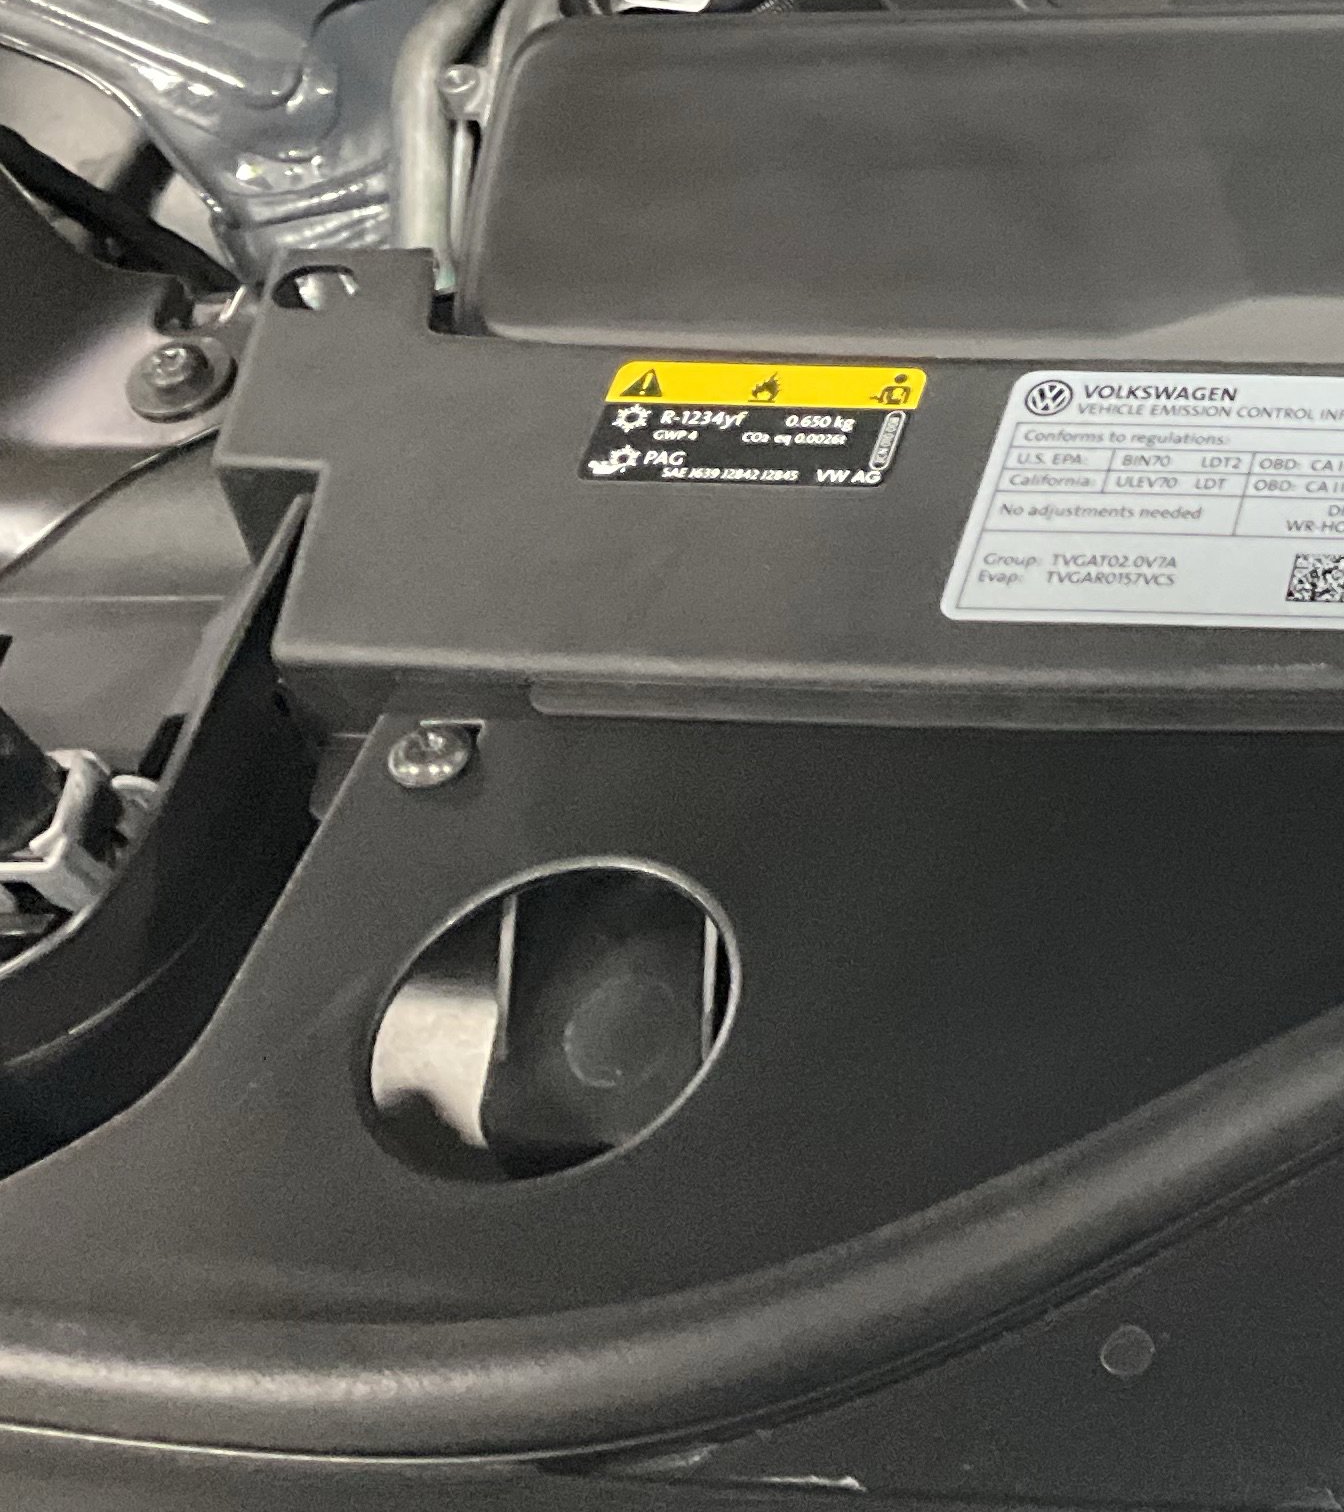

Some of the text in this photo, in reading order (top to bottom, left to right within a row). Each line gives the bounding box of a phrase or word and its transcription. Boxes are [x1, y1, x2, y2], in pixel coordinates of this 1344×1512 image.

[1083, 384, 1239, 402] VOLKSWAGEN
[1077, 402, 1145, 417] VEHICLE
[1149, 403, 1232, 418] EMISSION
[1236, 406, 1315, 420] CONTROL
[660, 409, 856, 433] R-1234yf 0.650 kg
[652, 429, 688, 441] GWP
[773, 434, 792, 446] eq
[1024, 429, 1105, 444] Conforms
[1109, 431, 1126, 444] to
[643, 450, 687, 466] PAG
[1122, 454, 1172, 468] BIN70
[1200, 456, 1242, 470] LDT2
[1310, 459, 1335, 473] CA
[661, 467, 689, 479] SAE
[816, 469, 851, 483] VW
[850, 469, 883, 484] AG
[1116, 475, 1179, 489] ULEV70
[1194, 477, 1228, 491] LDT
[1305, 480, 1330, 494] CA
[999, 503, 1025, 517] No
[1028, 504, 1135, 521] adjustments
[1138, 506, 1203, 521] needed
